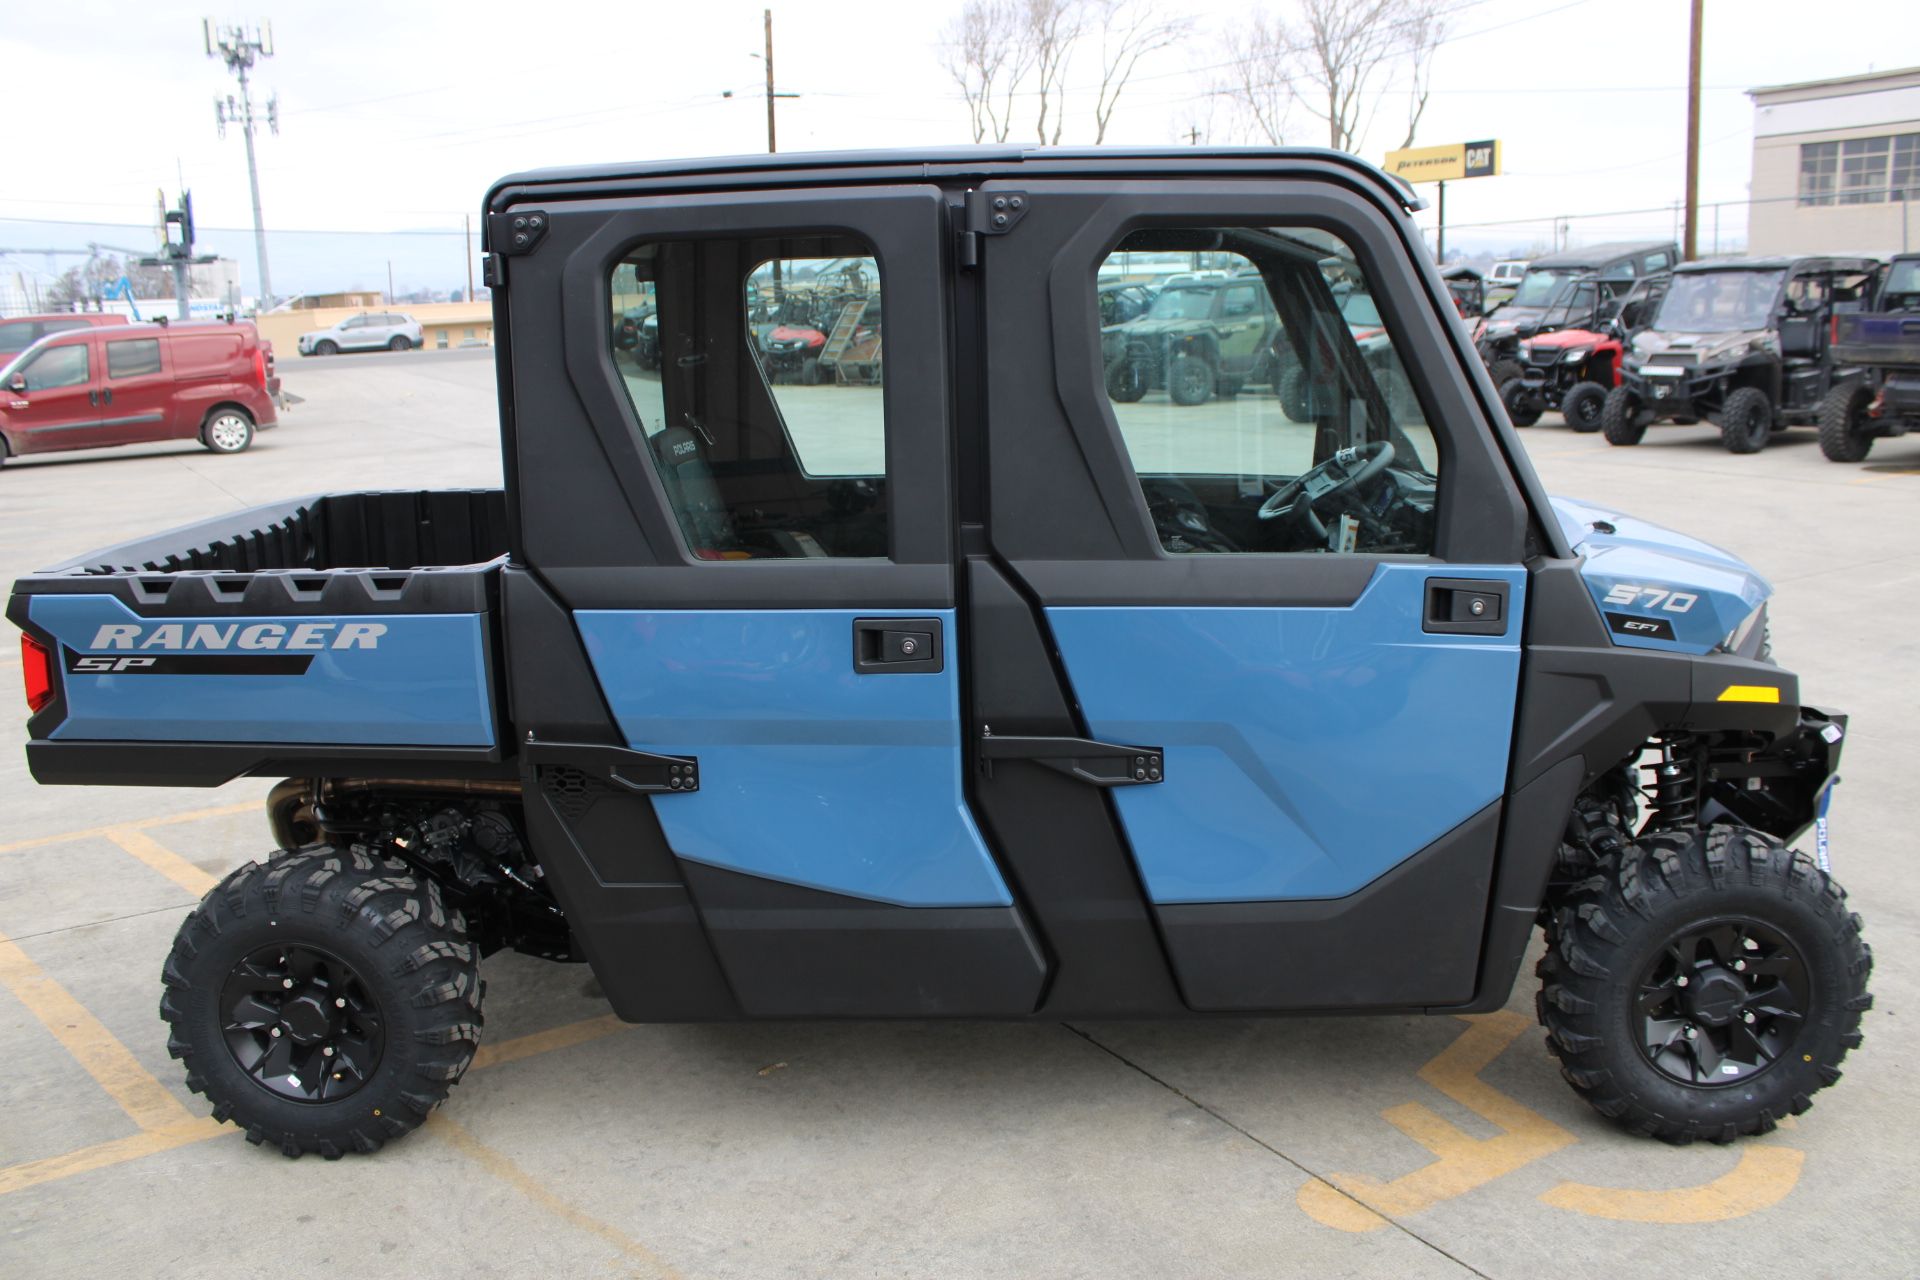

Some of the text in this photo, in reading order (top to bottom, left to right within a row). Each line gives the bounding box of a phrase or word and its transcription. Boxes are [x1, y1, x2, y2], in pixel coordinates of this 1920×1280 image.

[1466, 148, 1491, 168] CAT
[1603, 584, 1698, 613] 570
[90, 623, 388, 650] RANGER
[1623, 621, 1660, 632] EFI
[72, 657, 157, 671] SP
